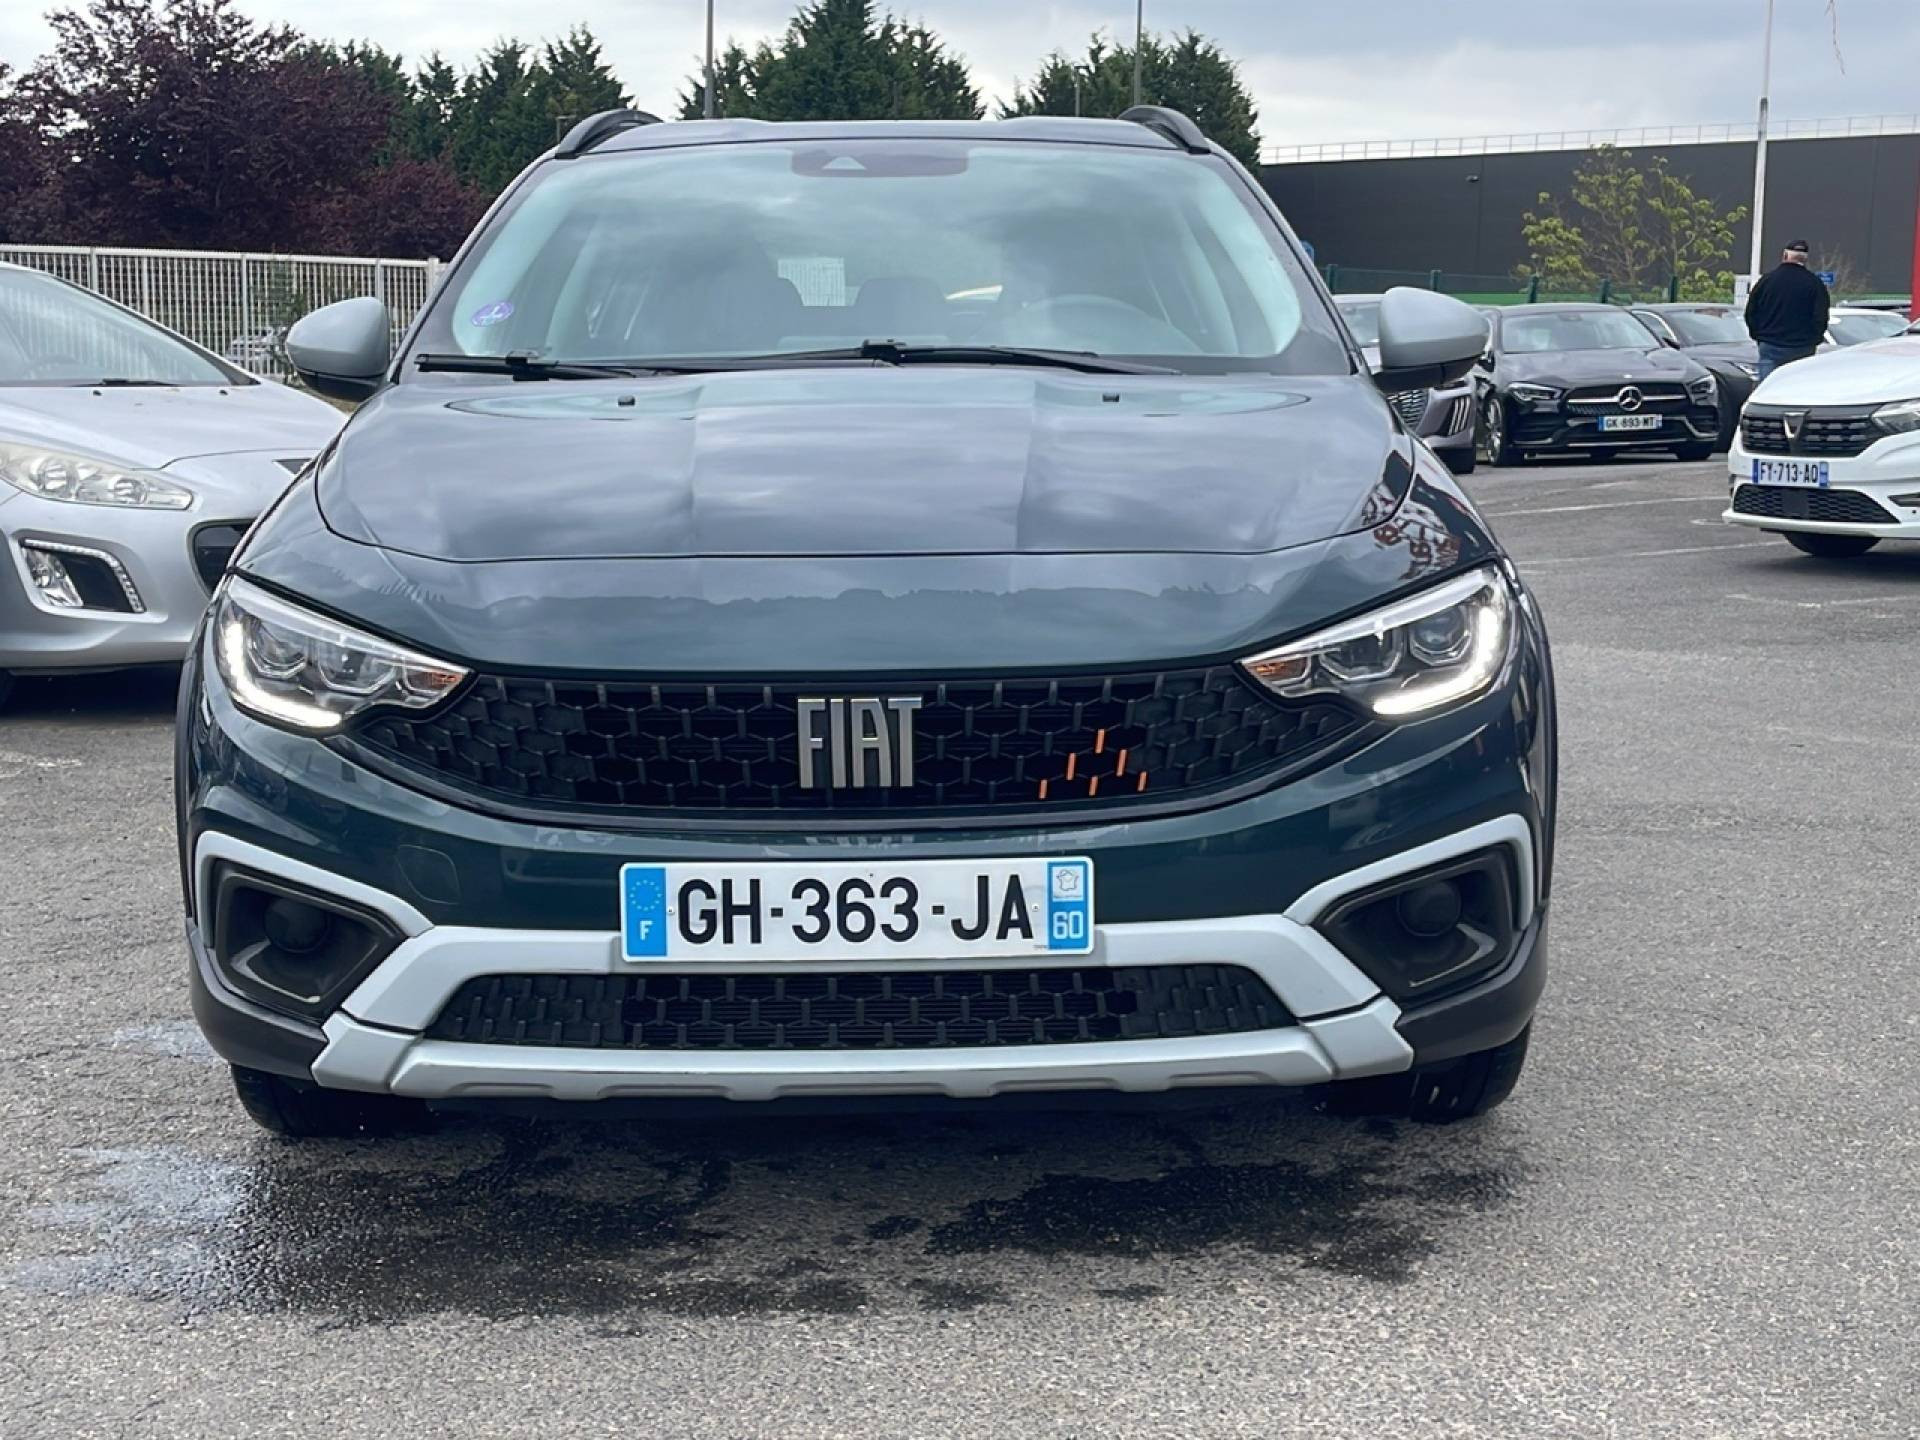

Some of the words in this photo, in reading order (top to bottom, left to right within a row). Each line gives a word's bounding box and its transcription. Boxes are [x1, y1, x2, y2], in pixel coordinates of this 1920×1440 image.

[797, 697, 922, 788] FIAT
[639, 920, 653, 941] F
[677, 874, 1034, 945] GH-363-JA
[1052, 911, 1084, 940] 60
